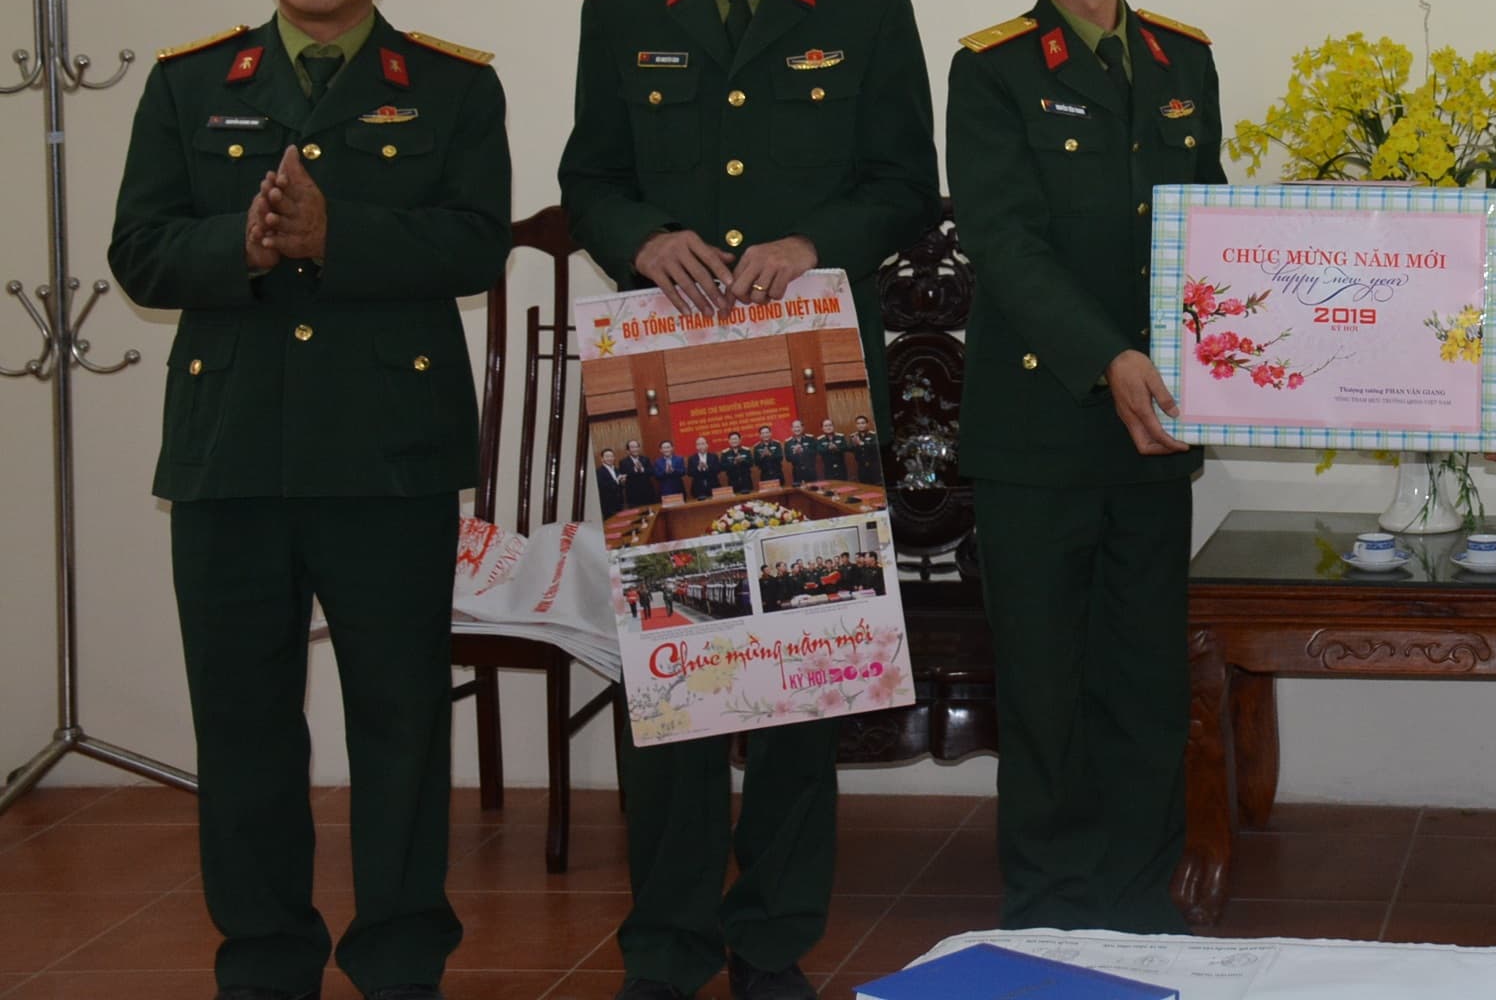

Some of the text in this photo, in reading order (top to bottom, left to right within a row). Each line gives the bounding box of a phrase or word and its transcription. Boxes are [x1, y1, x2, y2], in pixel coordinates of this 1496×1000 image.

[1222, 244, 1447, 269] CHÚC MỪNG NĂM MỚI
[1266, 262, 1320, 295] happy
[622, 318, 640, 341] BỘ
[642, 312, 676, 336] TỔNG
[785, 296, 811, 320] VIỆT
[813, 297, 840, 314] NAM
[1314, 306, 1377, 325] 2019
[648, 640, 721, 678] Chúc
[725, 634, 787, 690] mừng
[786, 629, 832, 656] năm
[836, 617, 873, 654] mới
